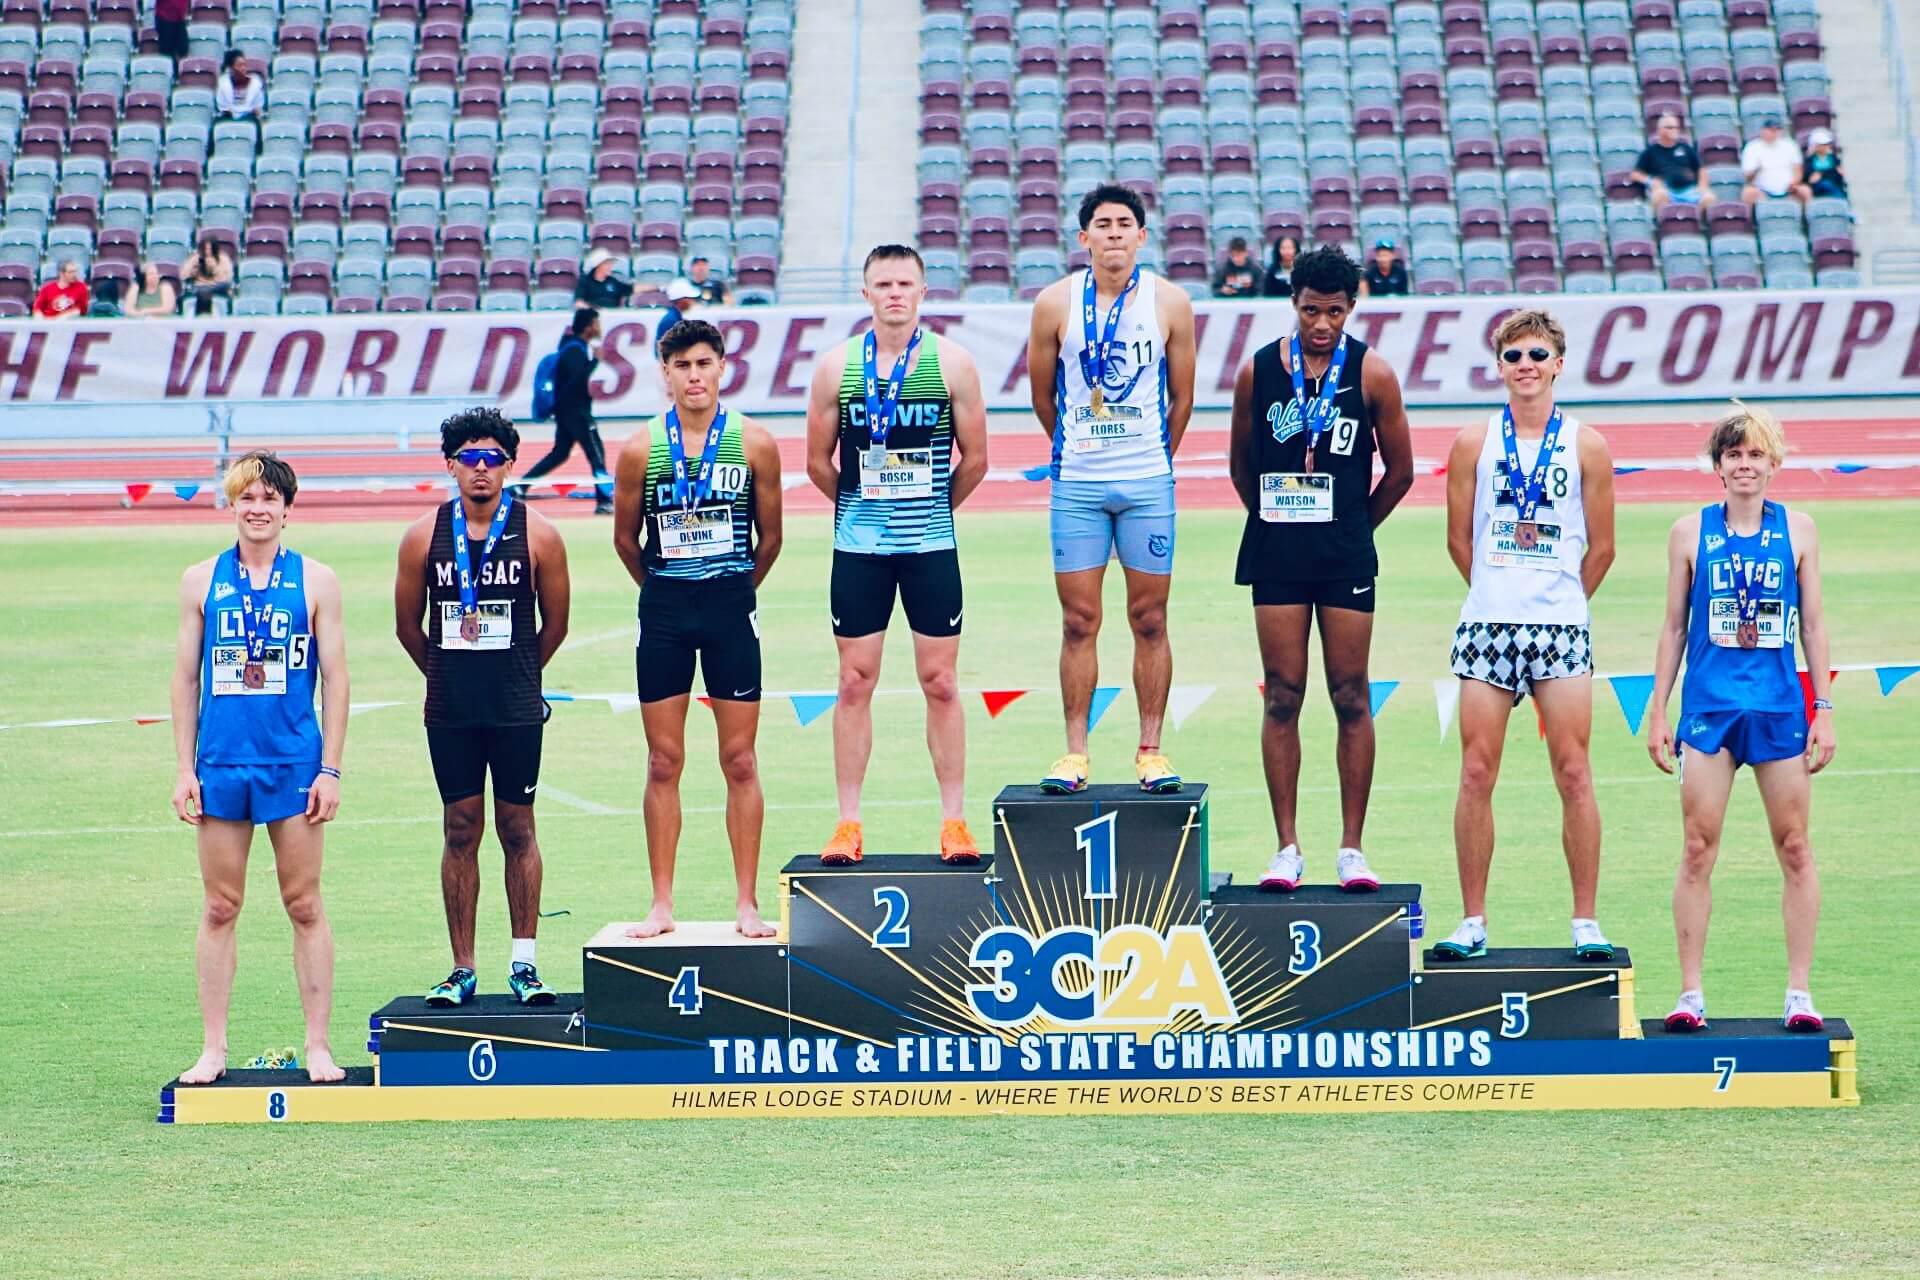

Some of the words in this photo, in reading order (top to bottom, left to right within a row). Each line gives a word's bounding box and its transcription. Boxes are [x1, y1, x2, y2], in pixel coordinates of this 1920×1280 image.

[1132, 340, 1152, 365] 11
[1584, 301, 1920, 386] COMP
[849, 404, 940, 427] CVIS
[1091, 423, 1126, 435] FLORES
[1337, 422, 1353, 451] 9
[719, 466, 741, 490] 10
[880, 472, 914, 483] BOSCH
[1553, 467, 1568, 498] 8
[1275, 495, 1316, 506] WATSON
[482, 560, 521, 585] SAC
[220, 611, 288, 639] LTC
[293, 636, 306, 668] 5
[1074, 810, 1118, 900] 1
[871, 886, 911, 949] 2
[1288, 920, 1322, 975] 3
[965, 924, 1241, 1025] 3C2A
[668, 966, 702, 1016] 4
[1500, 992, 1529, 1038] 5
[468, 1039, 497, 1081] 6
[709, 1037, 839, 1074] TRACK
[855, 1042, 880, 1073] &
[897, 1035, 1002, 1072] FIELD
[1018, 1033, 1137, 1072] STATE
[1152, 1030, 1491, 1070] CHAMPIONSHIPS
[1712, 1057, 1736, 1092] 7
[267, 1090, 287, 1121] 8
[672, 1089, 757, 1108] HILMER
[765, 1089, 844, 1107] LODGE
[851, 1088, 952, 1106] STADIUM
[976, 1087, 1058, 1105] WHERE
[1067, 1086, 1111, 1104] THE
[1119, 1085, 1223, 1103] WORLD'S
[1231, 1085, 1292, 1102] BEST
[1297, 1084, 1414, 1102] ATHLETES
[1422, 1082, 1535, 1101] COMPETE
